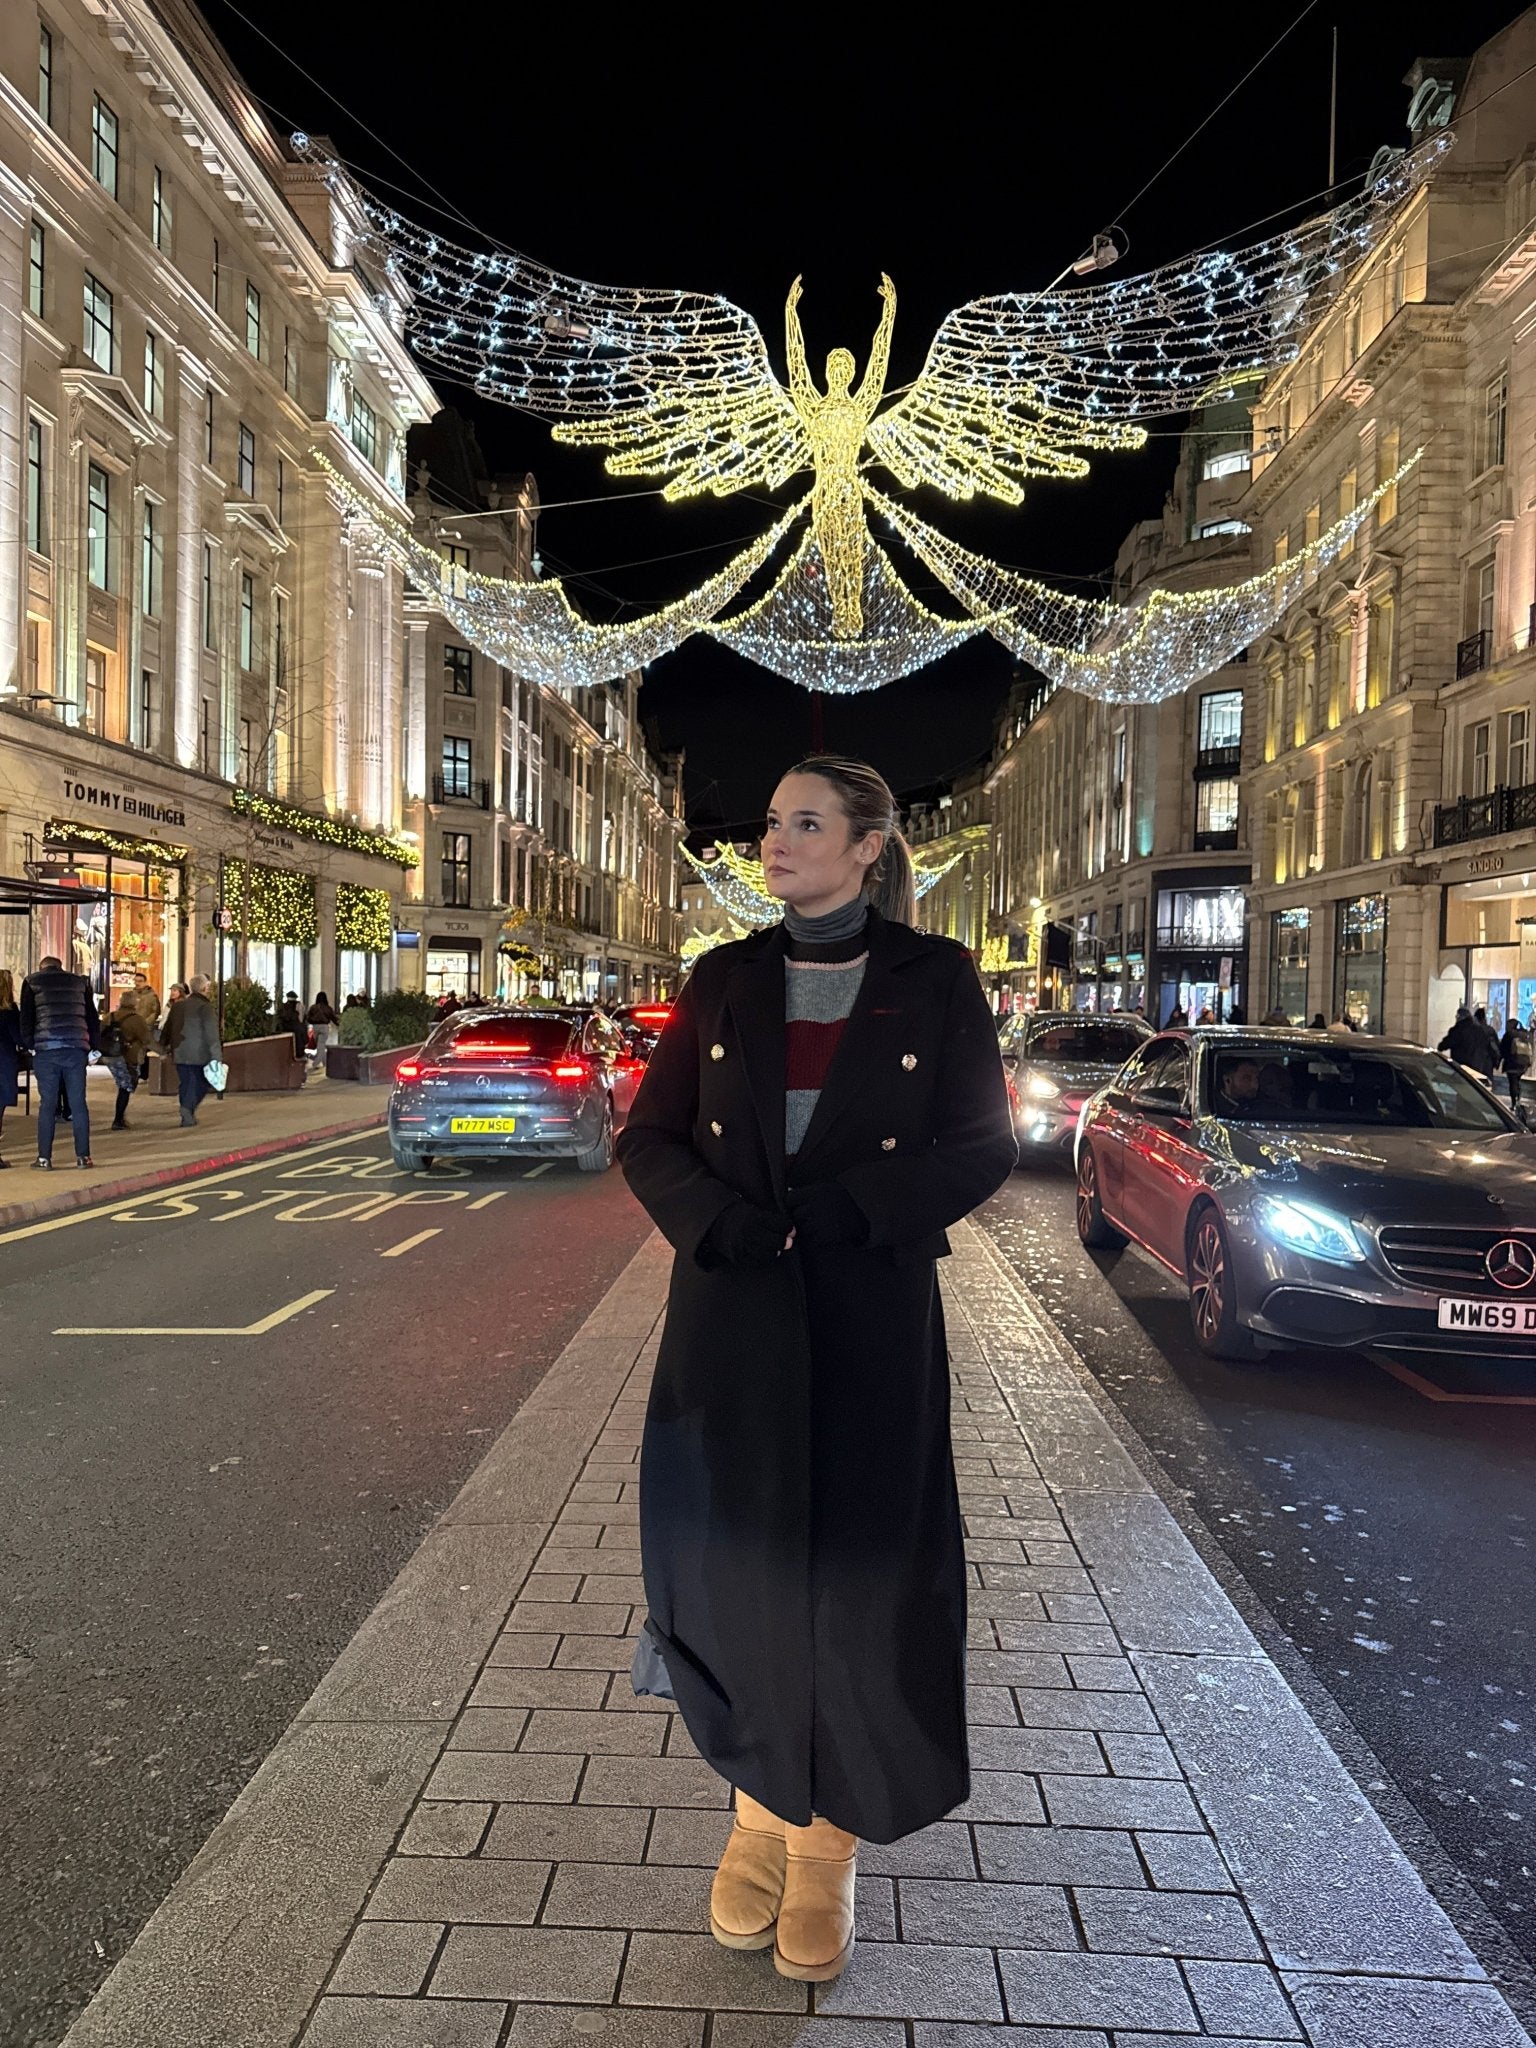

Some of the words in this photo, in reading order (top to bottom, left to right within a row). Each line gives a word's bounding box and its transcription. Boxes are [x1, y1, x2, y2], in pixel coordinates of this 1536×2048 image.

[64, 780, 121, 810] TOMMY
[138, 801, 186, 827] HILFIGER
[1467, 857, 1504, 875] SANDRO
[276, 1156, 499, 1179] BUS
[109, 1190, 470, 1223] STOP
[1450, 1303, 1516, 1328] MW69
